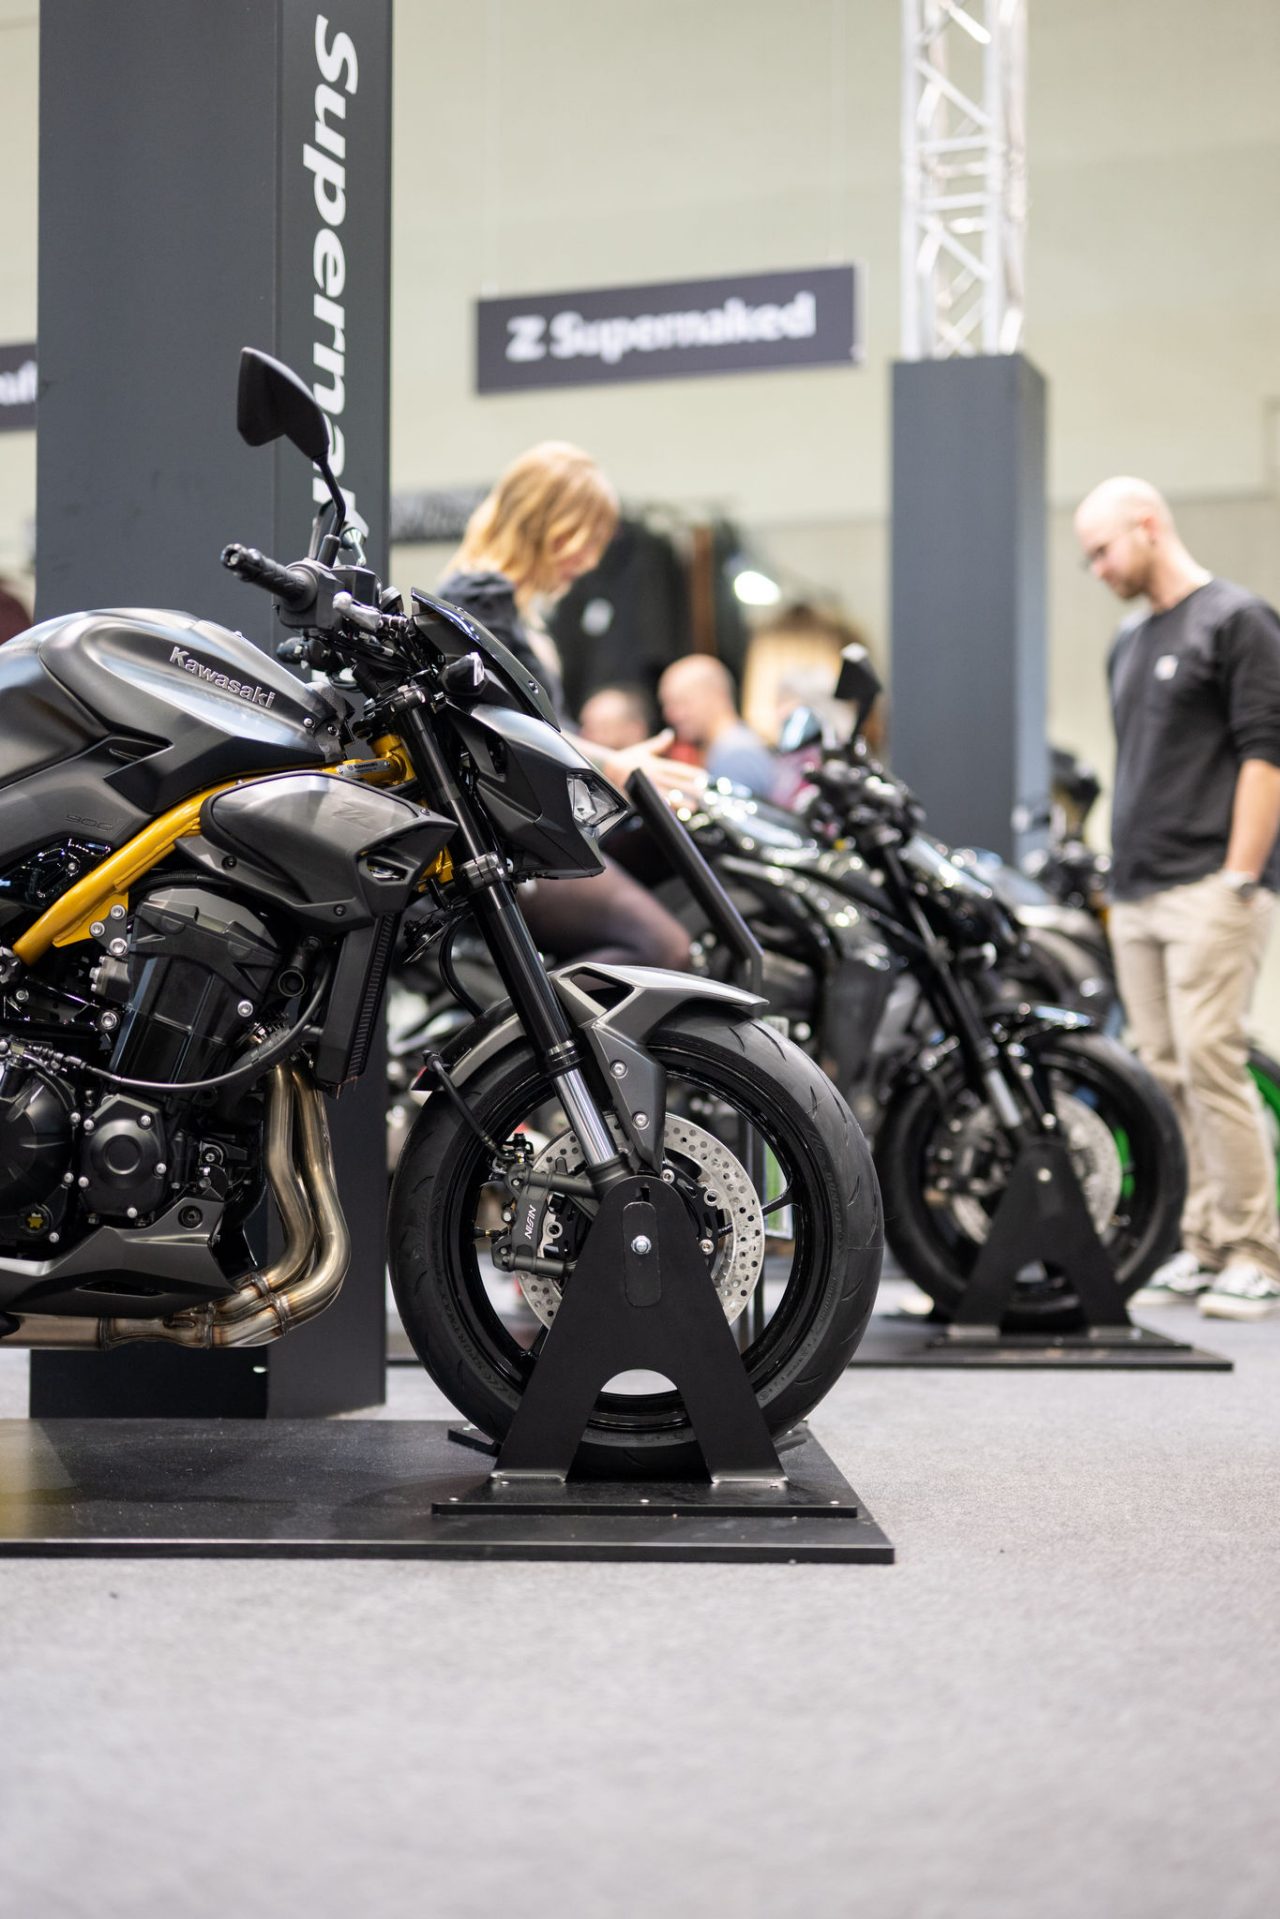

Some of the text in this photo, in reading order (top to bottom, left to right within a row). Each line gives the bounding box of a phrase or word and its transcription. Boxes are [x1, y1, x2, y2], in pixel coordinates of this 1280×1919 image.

[506, 291, 816, 364] Z Supernaked
[169, 646, 276, 709] Kawasaki
[524, 1204, 536, 1240] NISSIN
